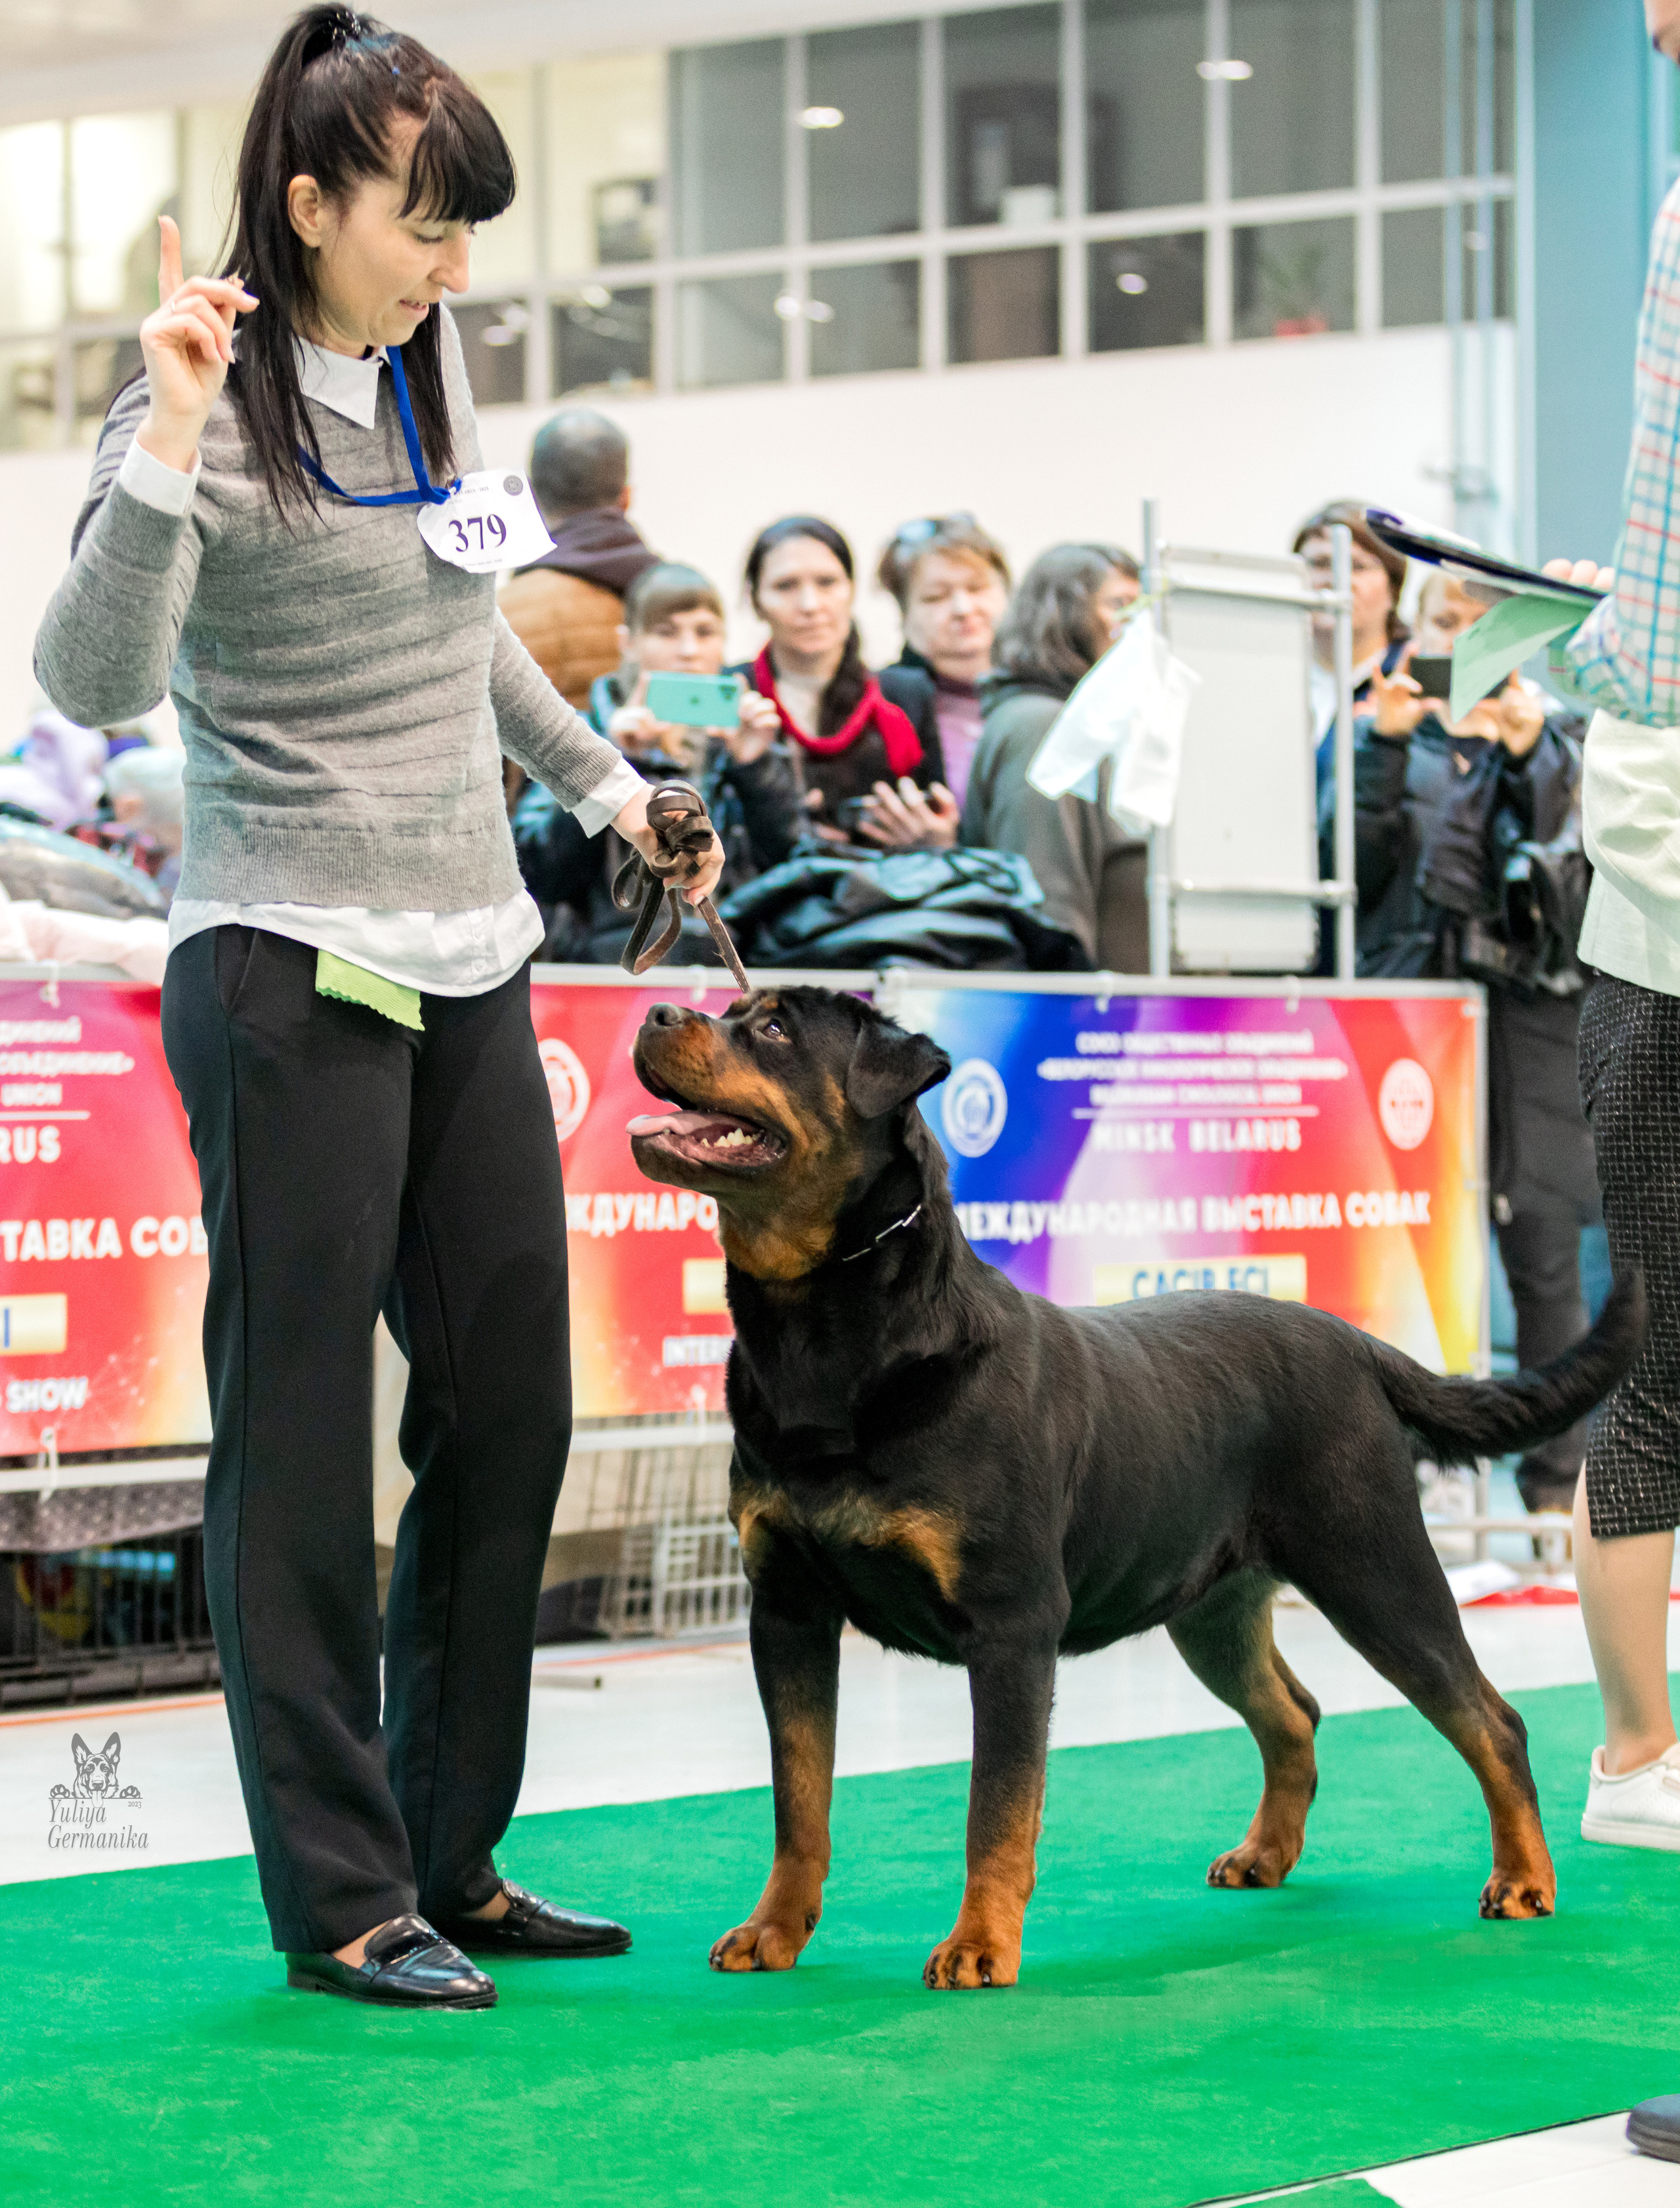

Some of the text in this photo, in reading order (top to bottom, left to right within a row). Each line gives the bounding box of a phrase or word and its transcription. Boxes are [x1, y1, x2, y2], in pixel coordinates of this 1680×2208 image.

[449, 514, 507, 552] 379
[1188, 1118, 1301, 1152] BELARUS
[1202, 1193, 1343, 1233] ВЫСТАВКА
[1345, 1190, 1431, 1228] СОБАК
[6, 1376, 89, 1414] SHOW
